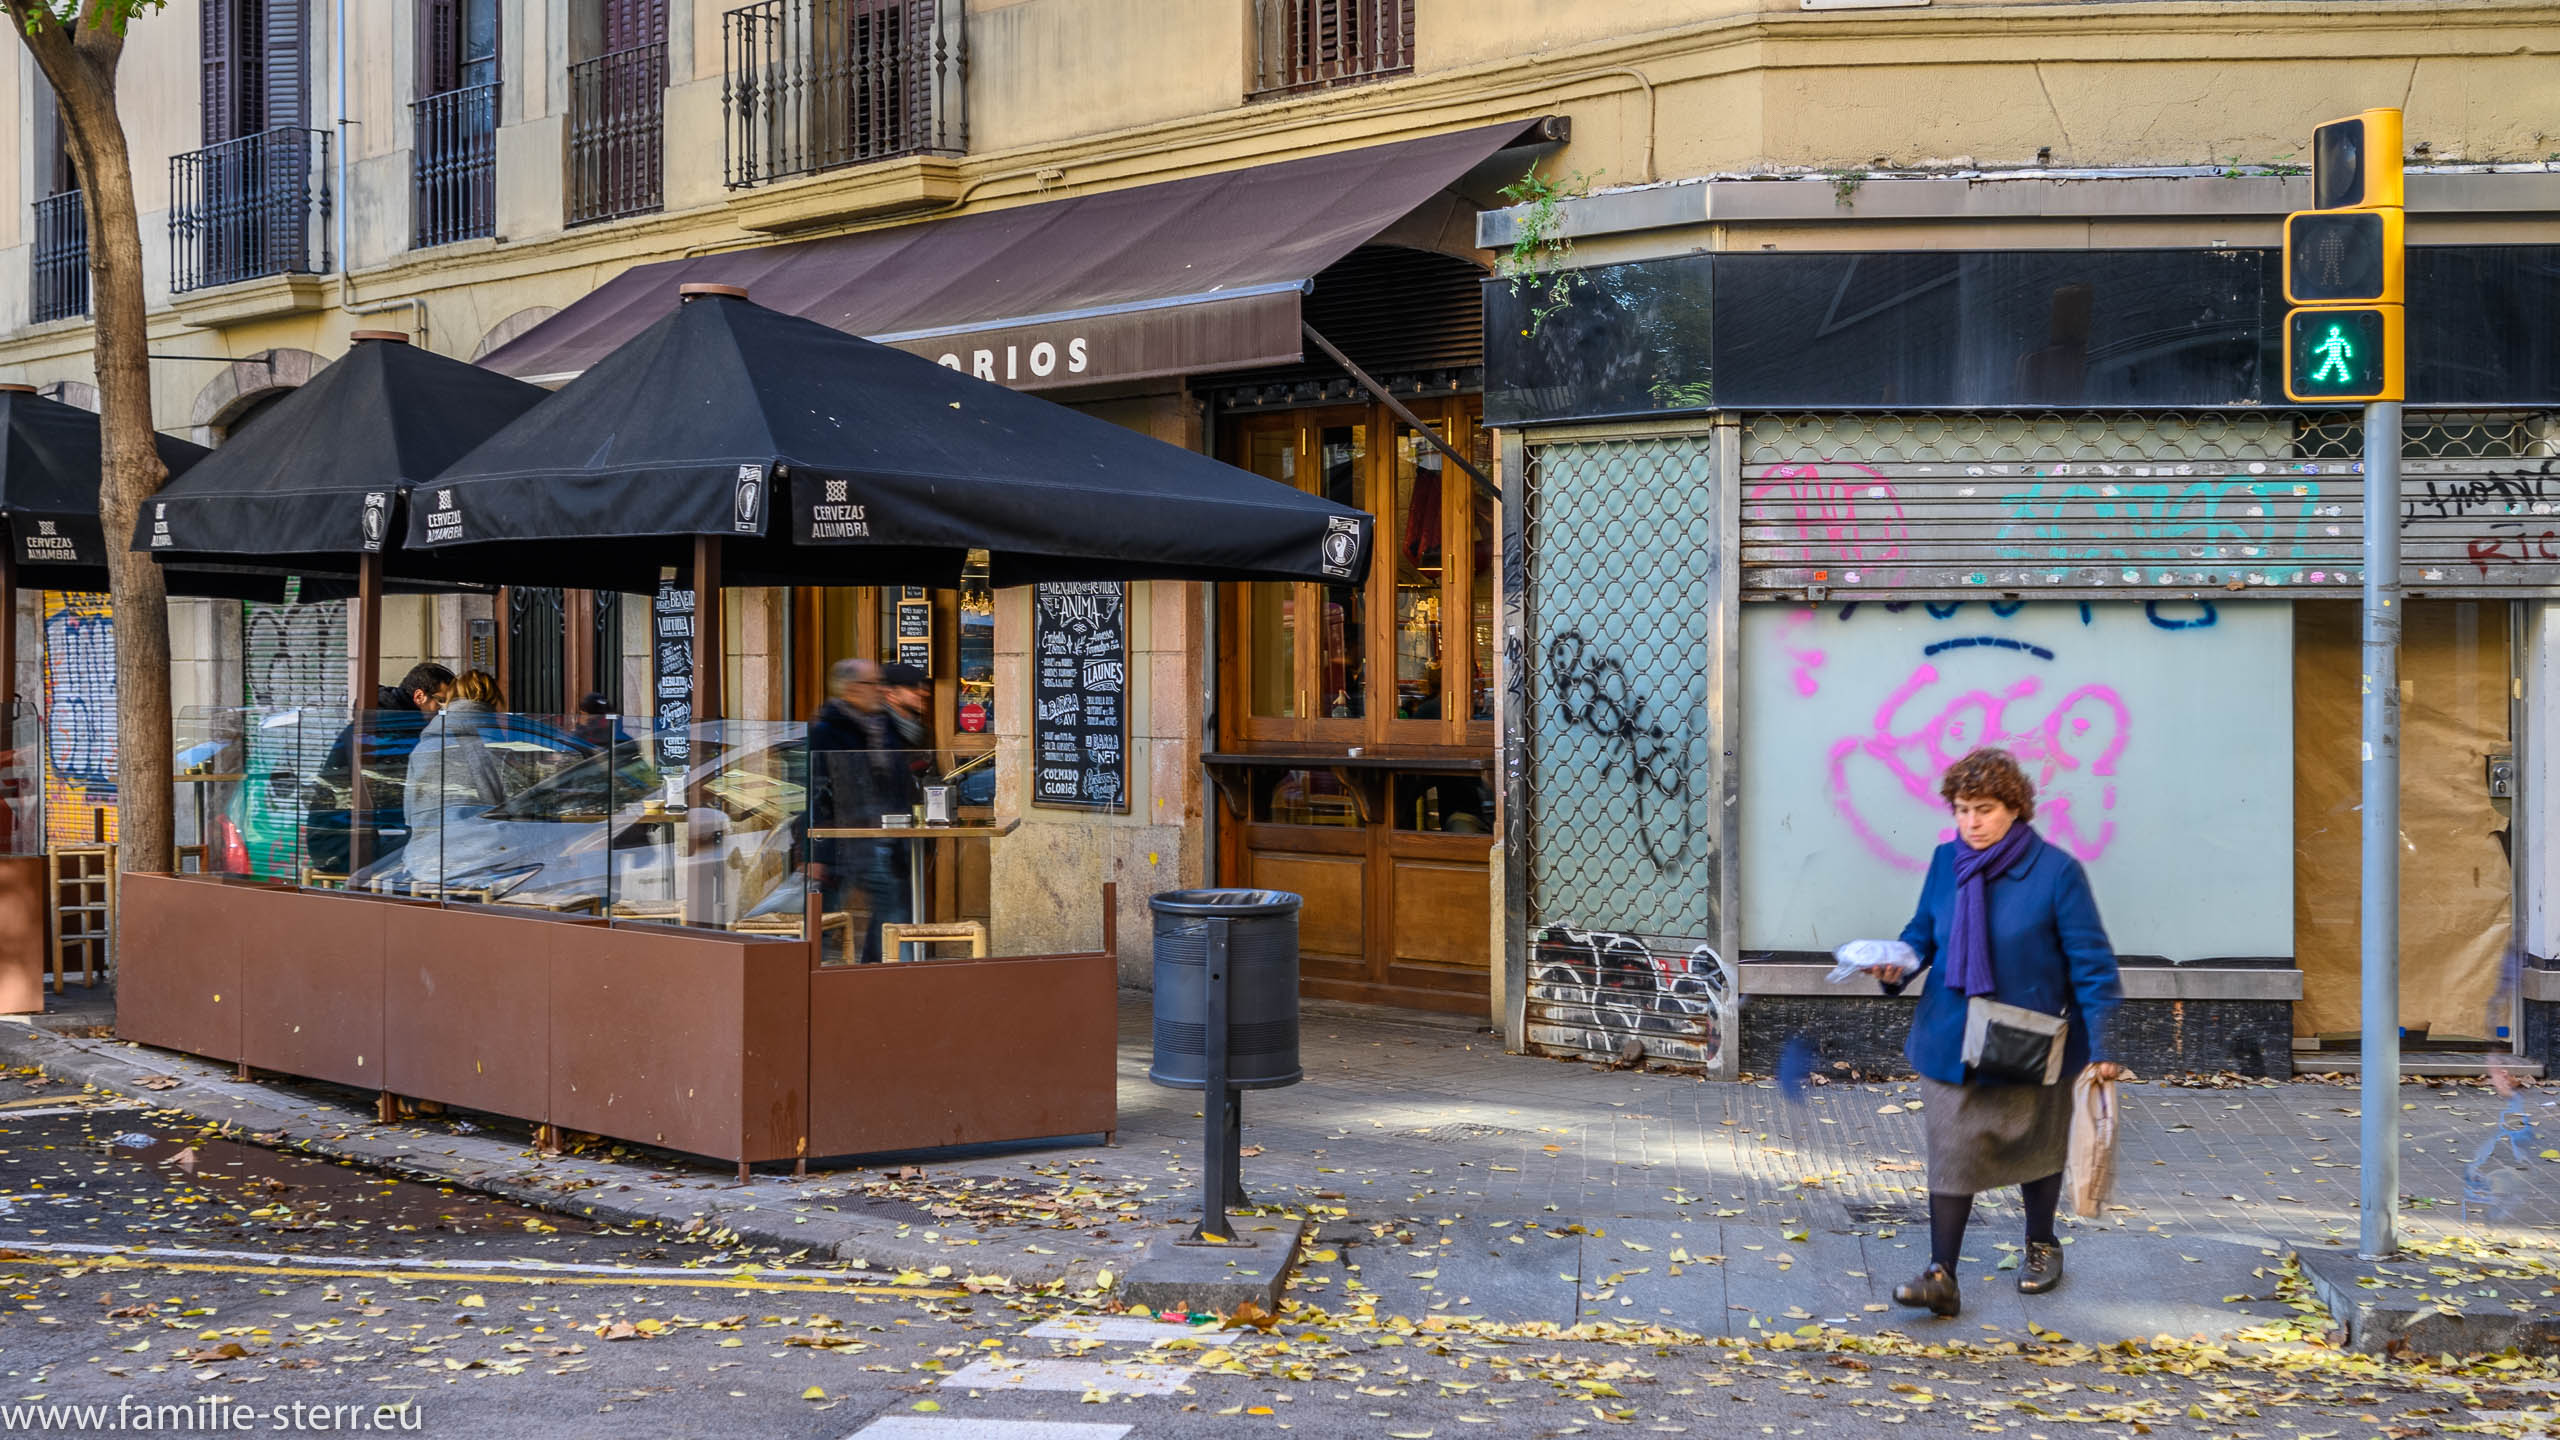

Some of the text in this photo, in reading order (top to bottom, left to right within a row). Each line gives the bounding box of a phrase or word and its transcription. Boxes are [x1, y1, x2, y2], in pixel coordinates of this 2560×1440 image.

[427, 510, 462, 528] CERVEZAS
[813, 505, 865, 521] CERVEZAS
[811, 521, 870, 538] ALHAMBRA
[26, 536, 73, 549] CERVEZAS
[27, 548, 77, 560] ALHAMBRA
[1082, 662, 1124, 690] LLAUNES
[1048, 693, 1080, 721] BARRA
[1063, 713, 1077, 726] AVI
[1097, 750, 1116, 764] NET
[1043, 768, 1079, 781] COLMADO
